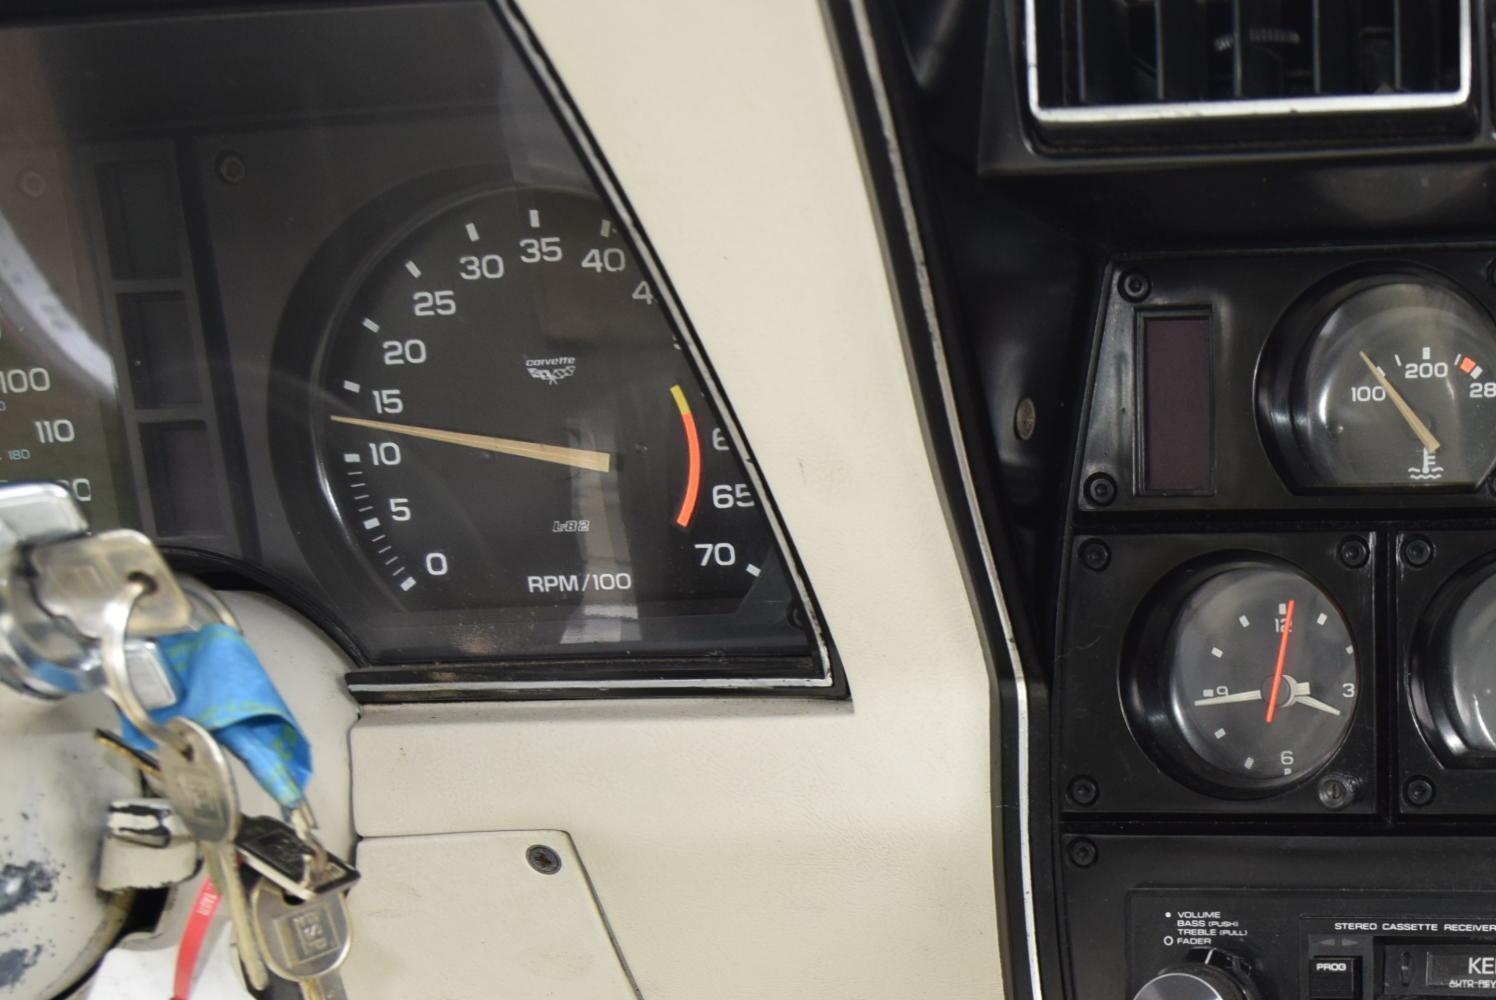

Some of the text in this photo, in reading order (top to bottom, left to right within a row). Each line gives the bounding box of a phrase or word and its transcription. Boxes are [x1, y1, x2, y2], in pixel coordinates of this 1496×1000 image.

[519, 237, 563, 263] 35
[581, 248, 626, 273] 40
[459, 254, 504, 280] 30
[413, 290, 456, 316] 25
[632, 281, 659, 305] 4
[382, 339, 427, 365] 20
[0, 367, 51, 394] 100
[1404, 362, 1448, 378] 200
[372, 389, 404, 414] 15
[1351, 386, 1386, 402] 100
[34, 419, 75, 443] 110
[8, 449, 31, 460] 180
[369, 442, 401, 466] 10
[712, 484, 755, 509] 65
[390, 498, 411, 521] 5
[425, 552, 448, 575] 0
[694, 543, 736, 566] 70
[527, 573, 632, 593] RPM/100
[1342, 683, 1355, 698] 3
[1281, 751, 1294, 765] 6
[1334, 922, 1496, 932] STEREO CASSETTE RECEIVER
[1177, 937, 1212, 945] FADER
[1316, 963, 1347, 972] PROG
